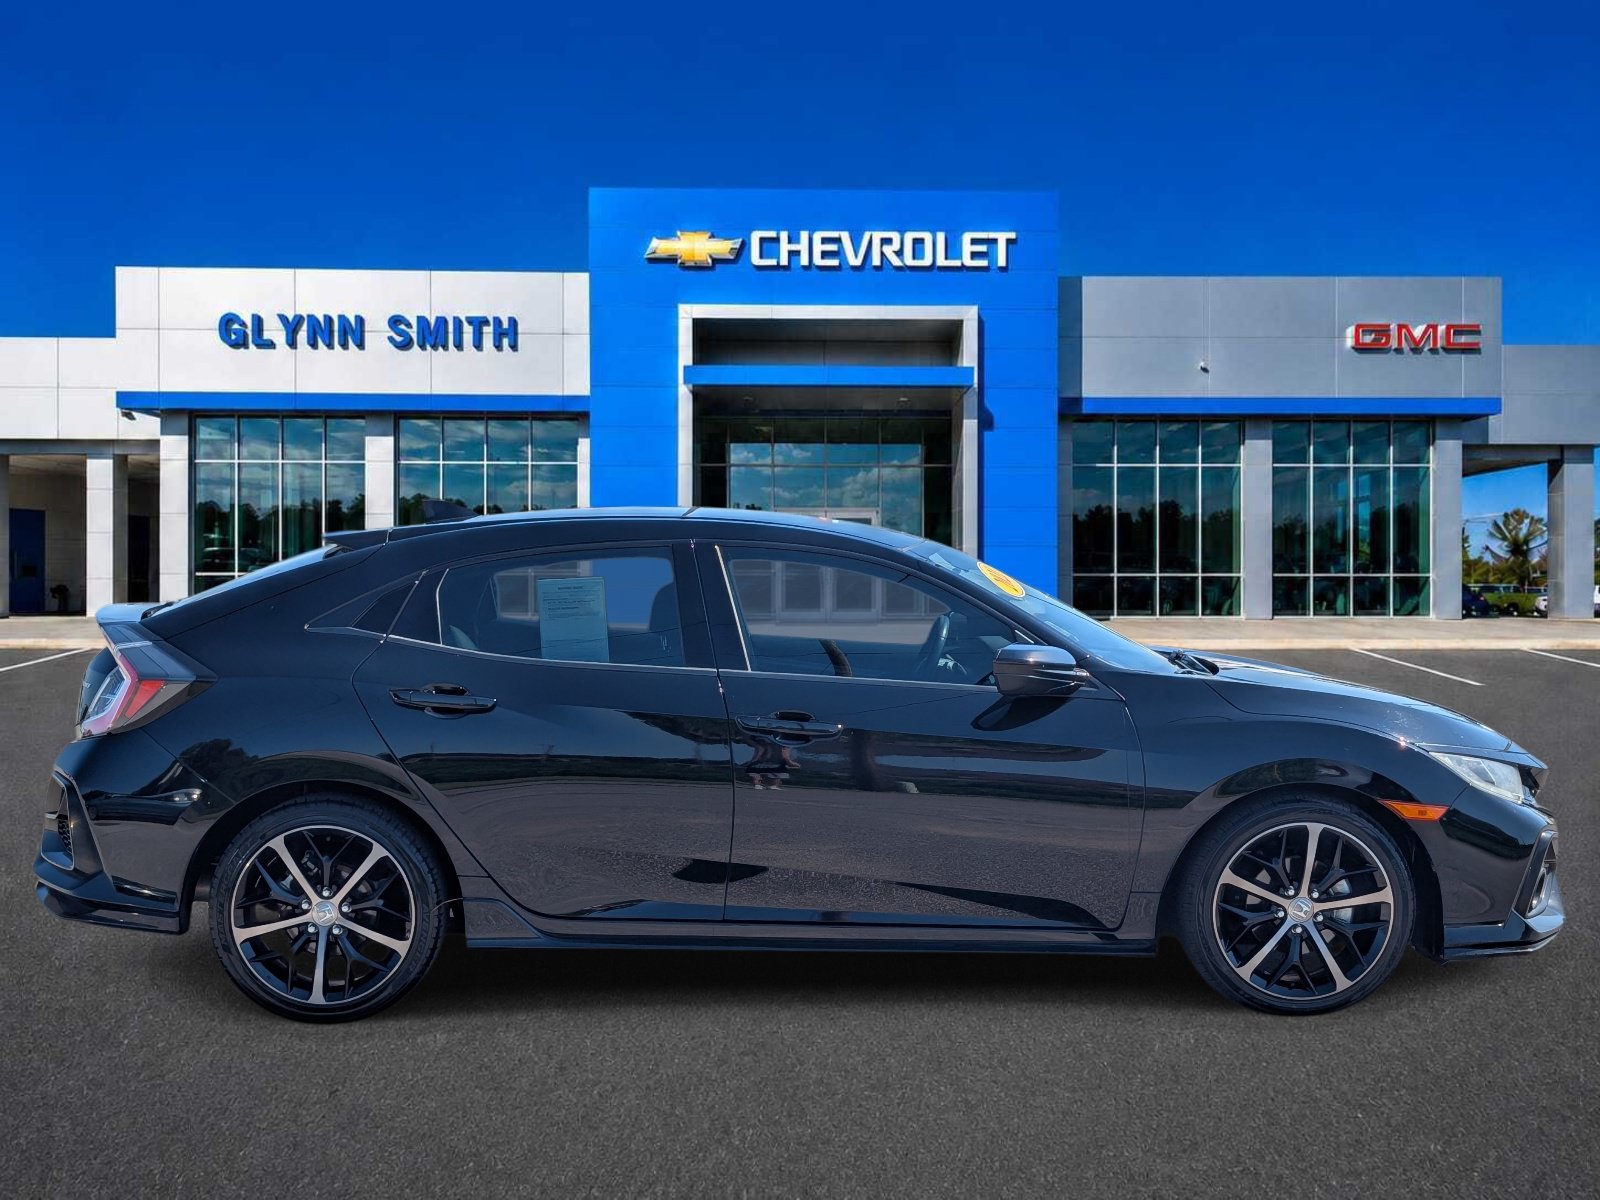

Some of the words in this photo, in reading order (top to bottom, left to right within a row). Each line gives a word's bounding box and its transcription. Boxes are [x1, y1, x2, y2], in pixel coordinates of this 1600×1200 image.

[750, 230, 1016, 269] CHEVROLET
[218, 312, 365, 350] GLYNN
[387, 314, 518, 351] SMITH
[1348, 323, 1482, 351] GMC
